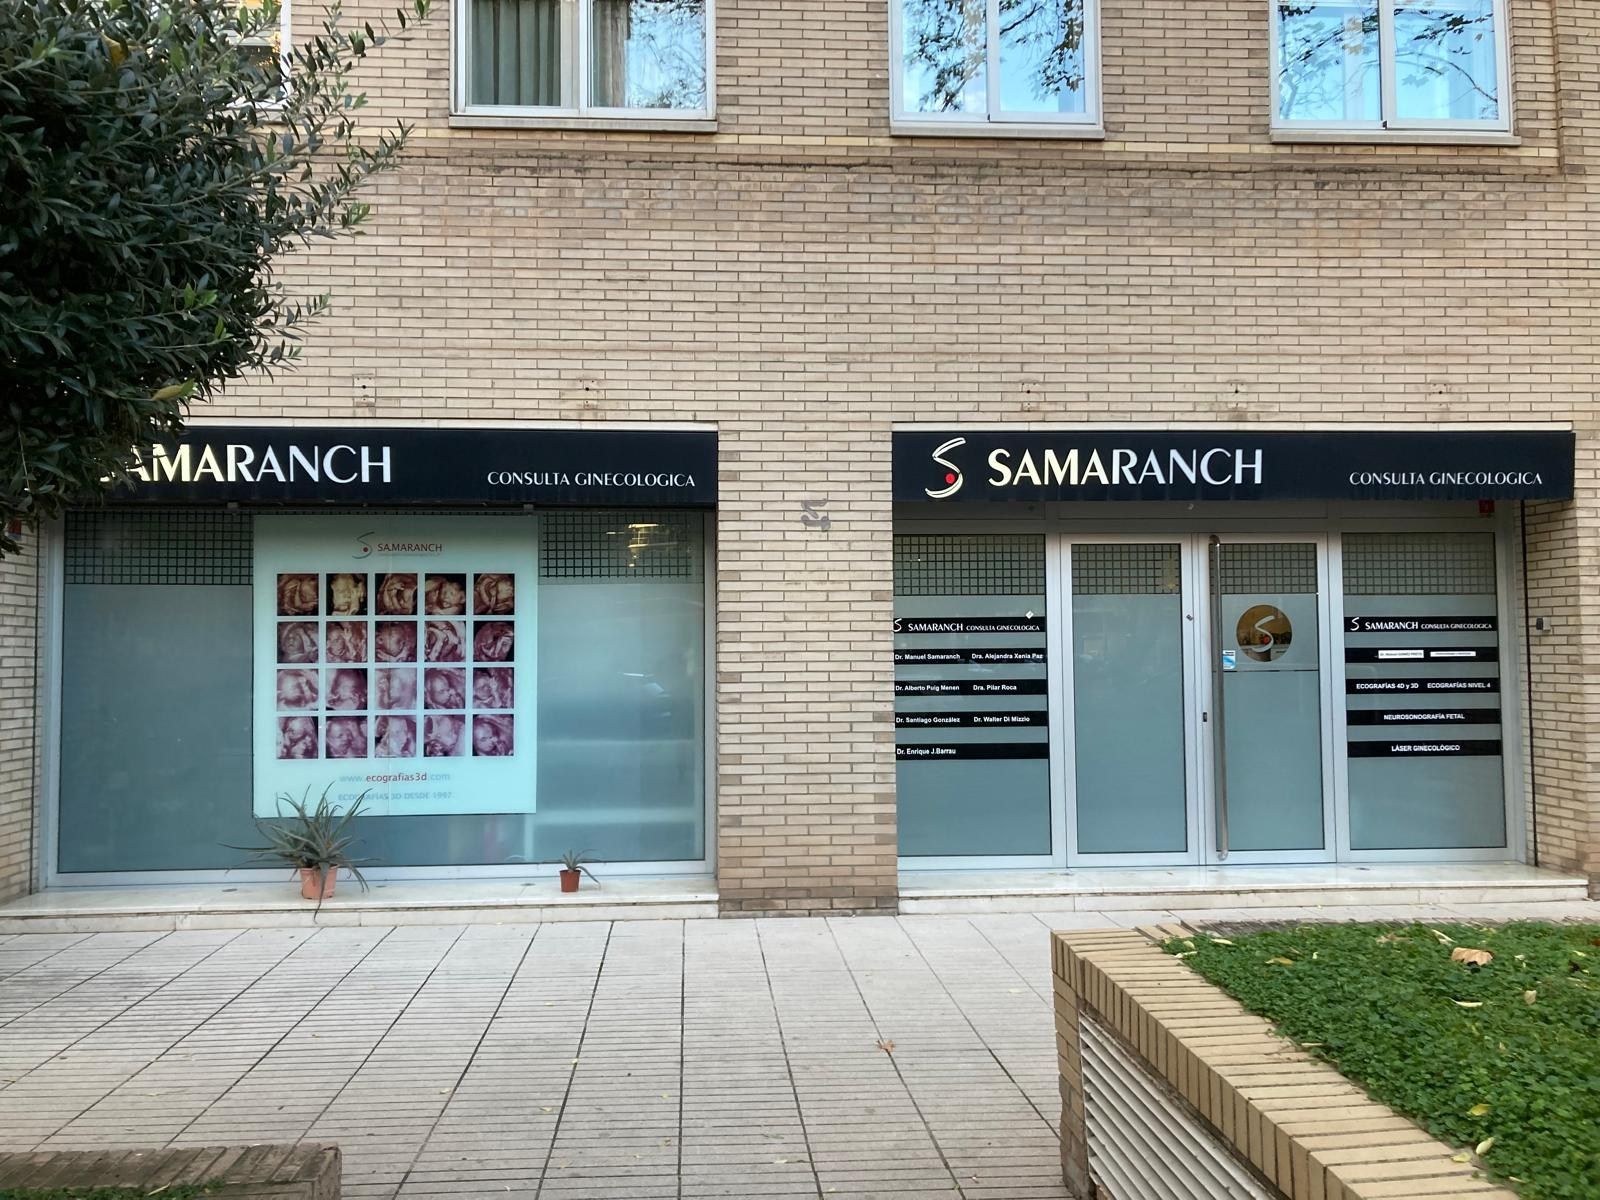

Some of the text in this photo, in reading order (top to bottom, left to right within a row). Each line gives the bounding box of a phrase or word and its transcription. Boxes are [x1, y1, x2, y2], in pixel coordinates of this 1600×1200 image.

[100, 443, 392, 483] AMARANCH
[987, 448, 1263, 487] SAMARANCH
[487, 471, 696, 487] CONSULTA GINECOLOGICA
[1349, 471, 1543, 485] CONSULTA GINECOLOGICA
[377, 543, 443, 552] SAMARANCH
[908, 622, 964, 632] SAMARANCH
[1364, 621, 1419, 630] SAMARANCH
[983, 653, 1014, 661] Alejandra
[1356, 682, 1396, 690] ECOGRAFÍAS
[1427, 681, 1467, 689] ECOGRAFÍAS
[1383, 712, 1446, 721] NEUROSONOGRAFÍA
[906, 748, 930, 756] Enrique
[1391, 743, 1412, 752] LÁSER
